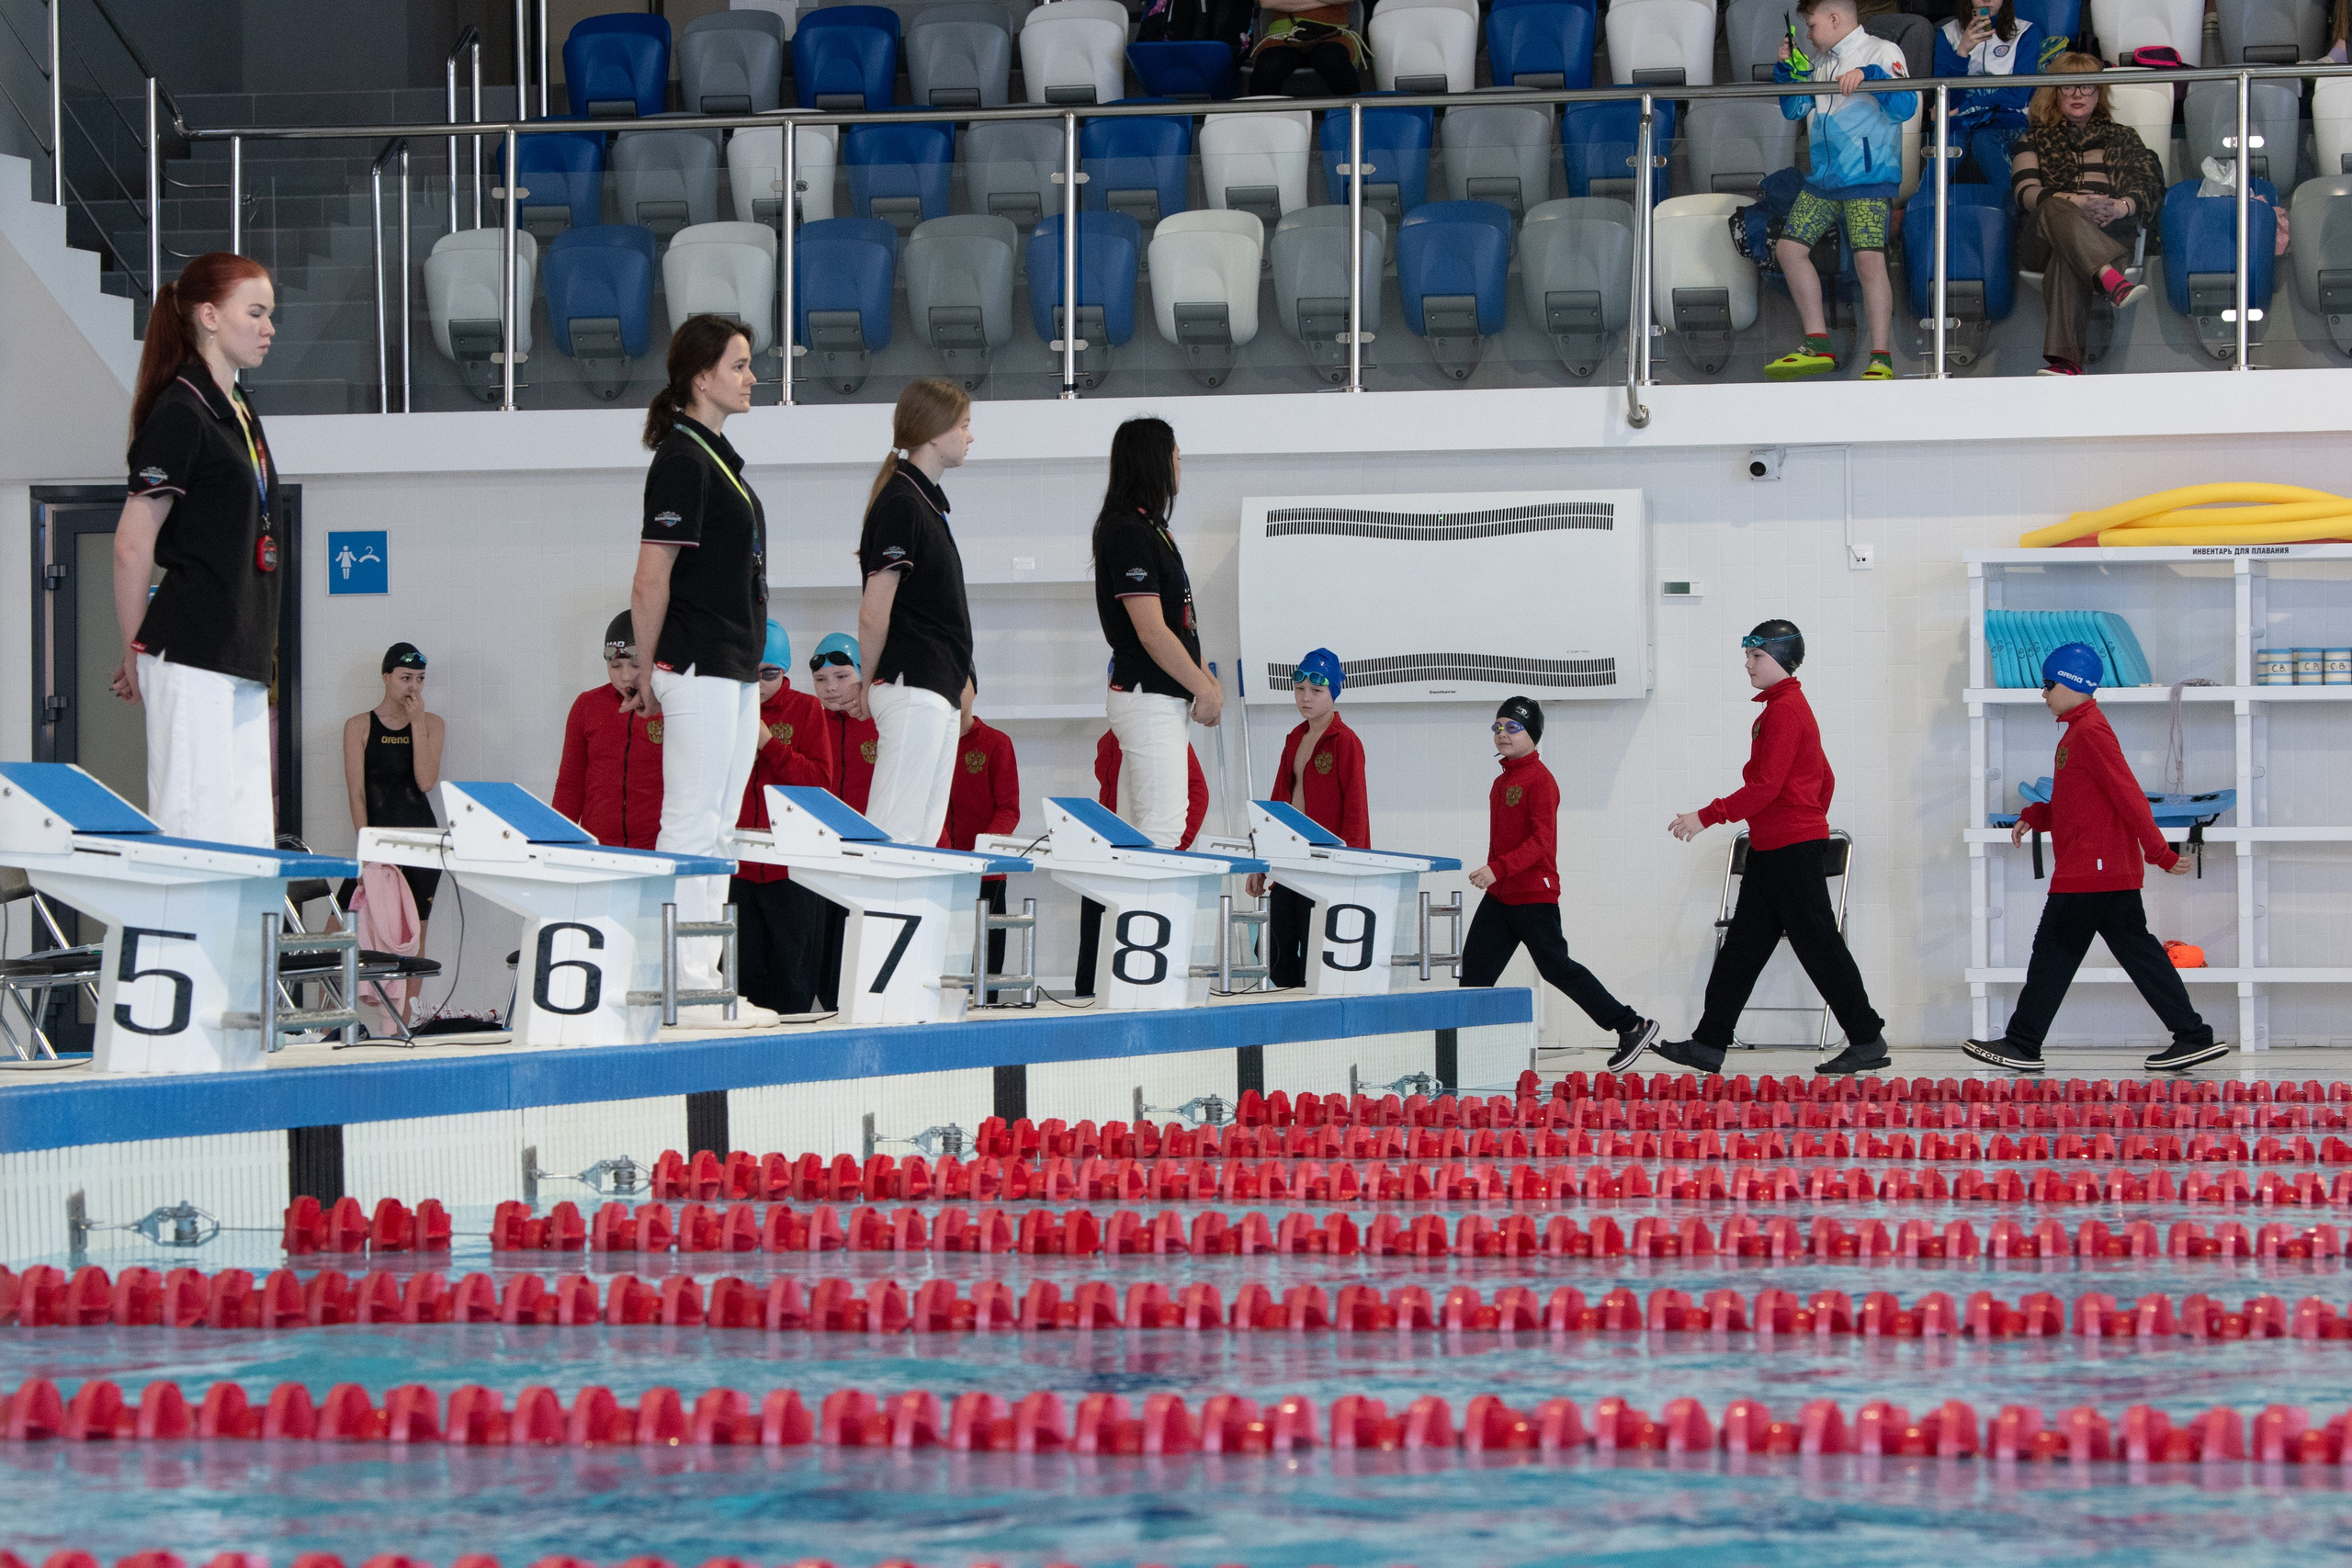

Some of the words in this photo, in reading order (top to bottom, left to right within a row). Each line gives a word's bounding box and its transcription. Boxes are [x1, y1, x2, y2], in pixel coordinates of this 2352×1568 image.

[2192, 547, 2233, 556] ИНВЕНТАРЬ
[2234, 547, 2250, 556] ДЛЯ
[2251, 547, 2290, 555] ПЛАВАНИЯ
[2057, 670, 2083, 683] arena
[380, 735, 410, 744] arena
[533, 922, 605, 1015] 6
[863, 910, 922, 994] 7
[1112, 910, 1171, 986] 8
[1322, 903, 1376, 972] 9
[113, 926, 197, 1036] 5
[1974, 1047, 2004, 1063] crocs
